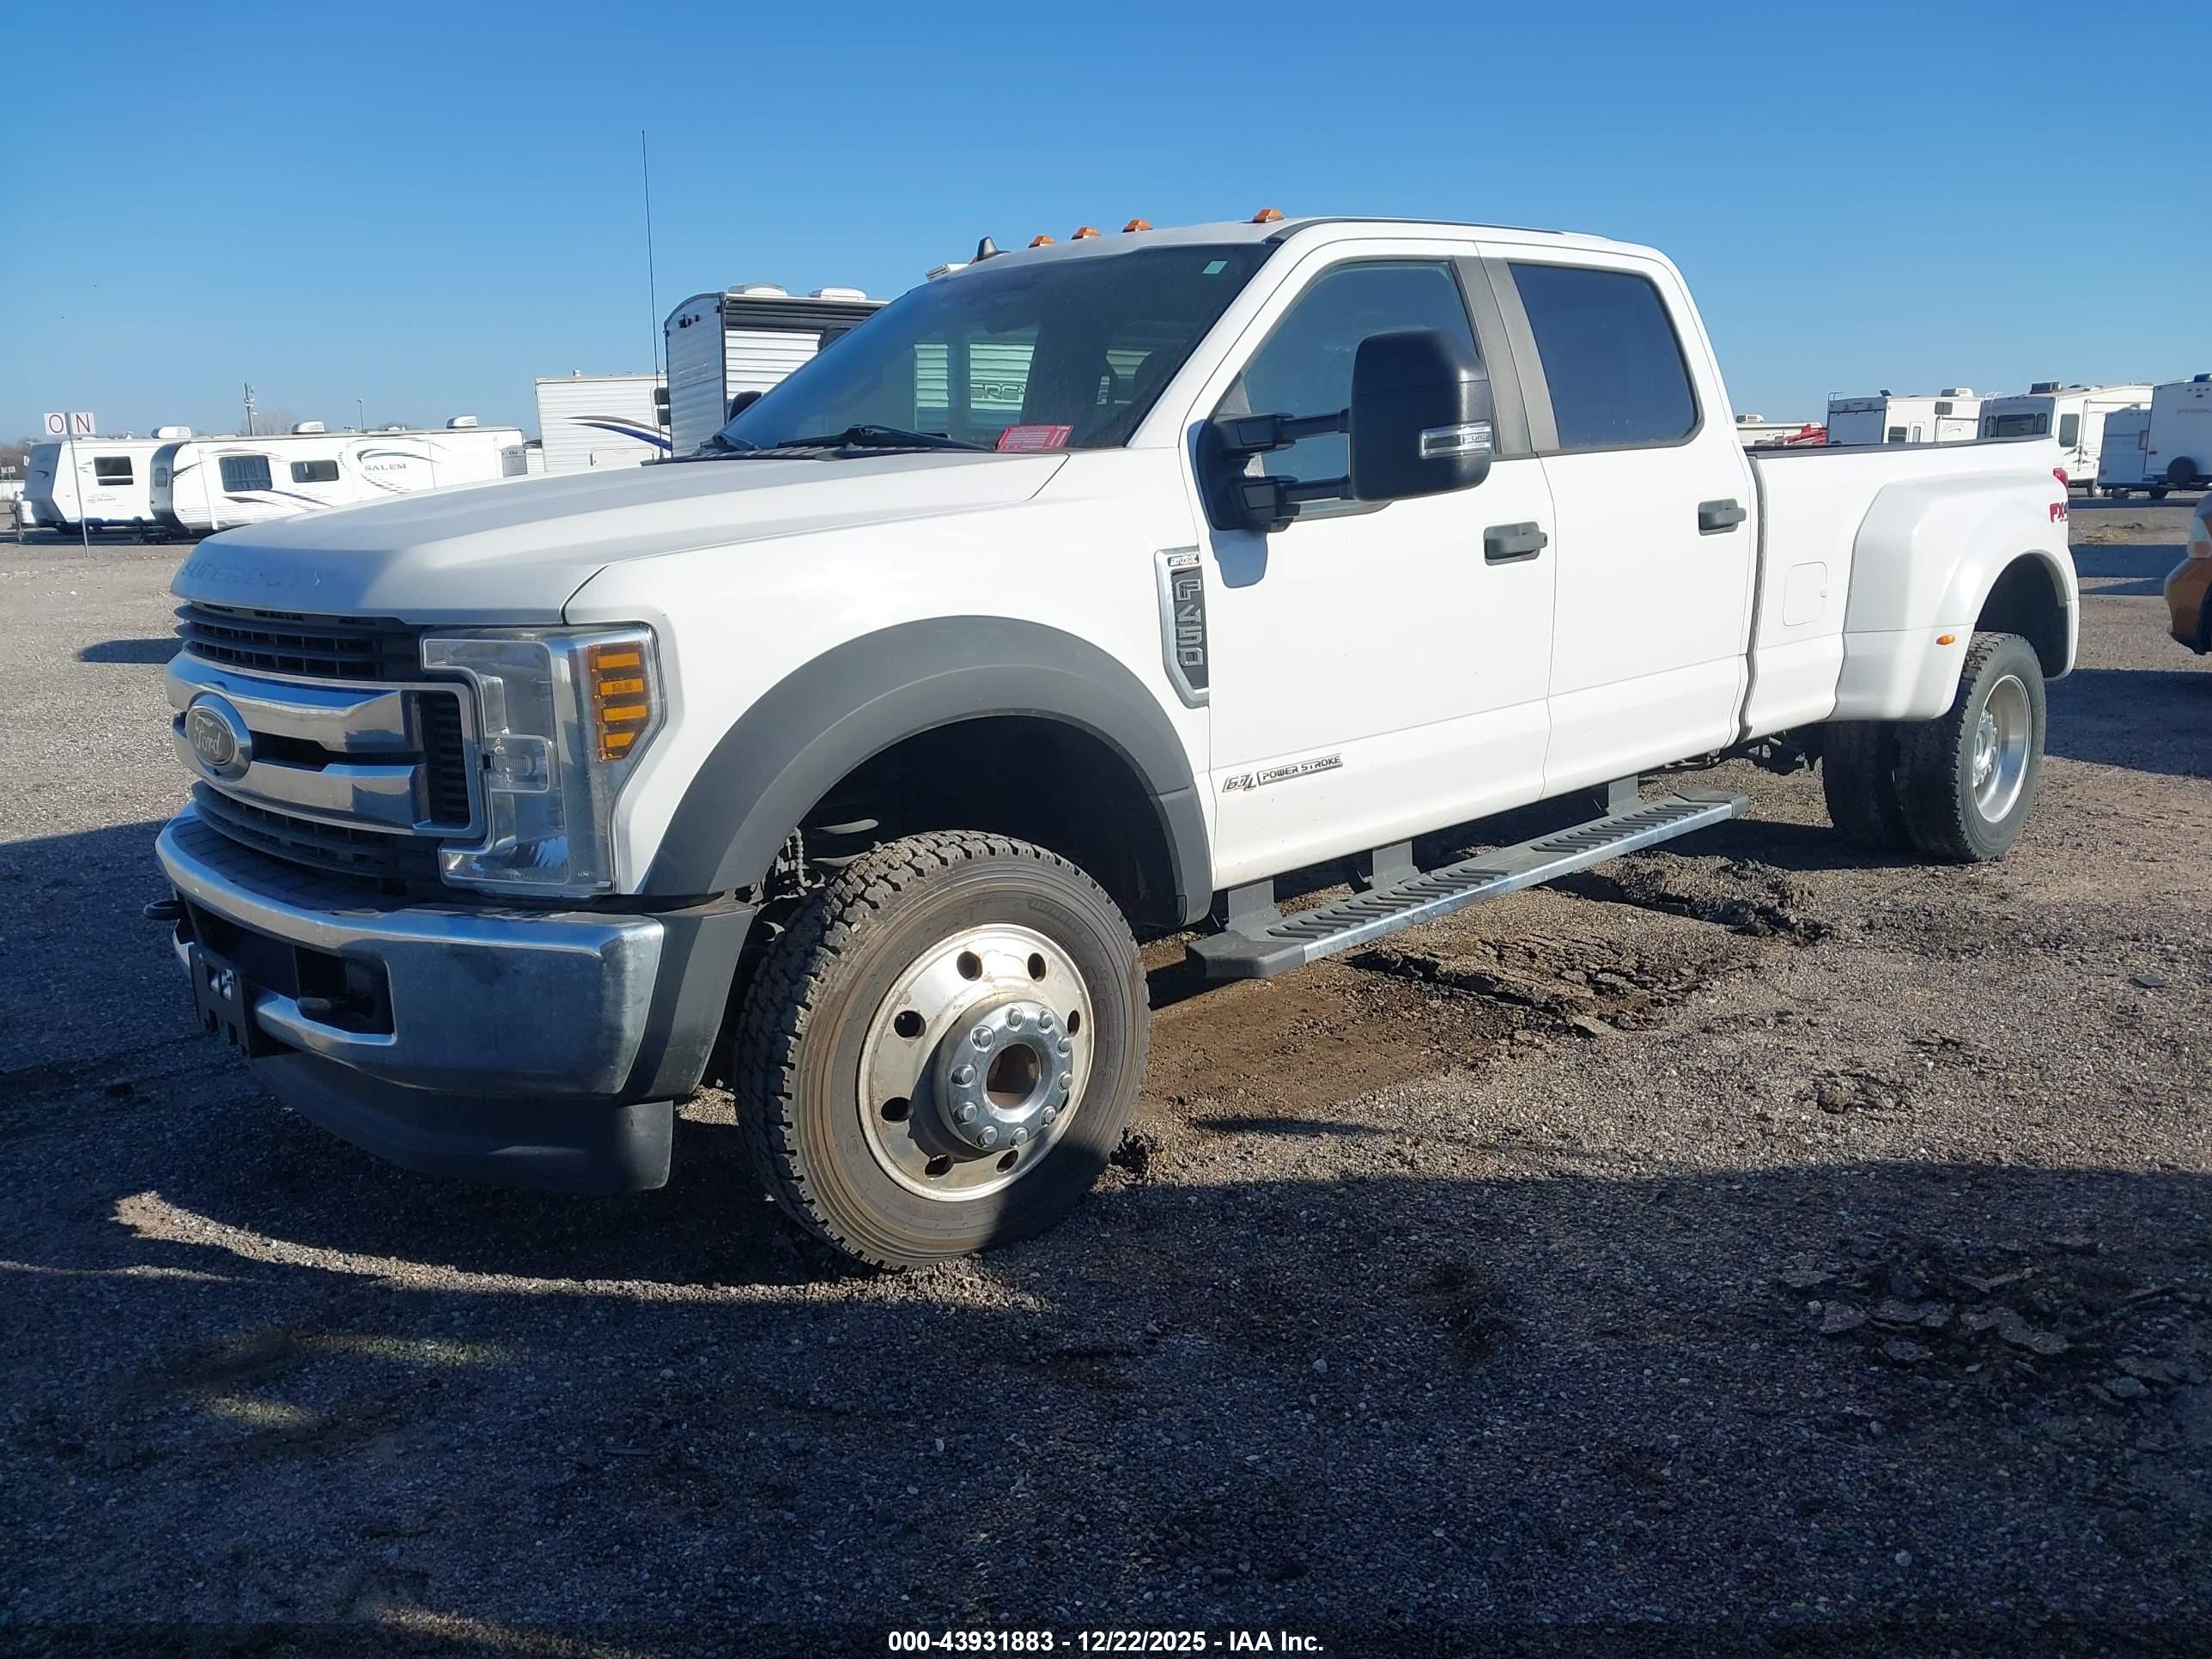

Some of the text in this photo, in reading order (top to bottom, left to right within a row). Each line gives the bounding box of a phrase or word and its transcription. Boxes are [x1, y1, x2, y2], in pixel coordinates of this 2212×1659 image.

[193, 716, 222, 757] Ford
[1261, 765, 1299, 781] POWER
[1301, 755, 1342, 771] STROKE
